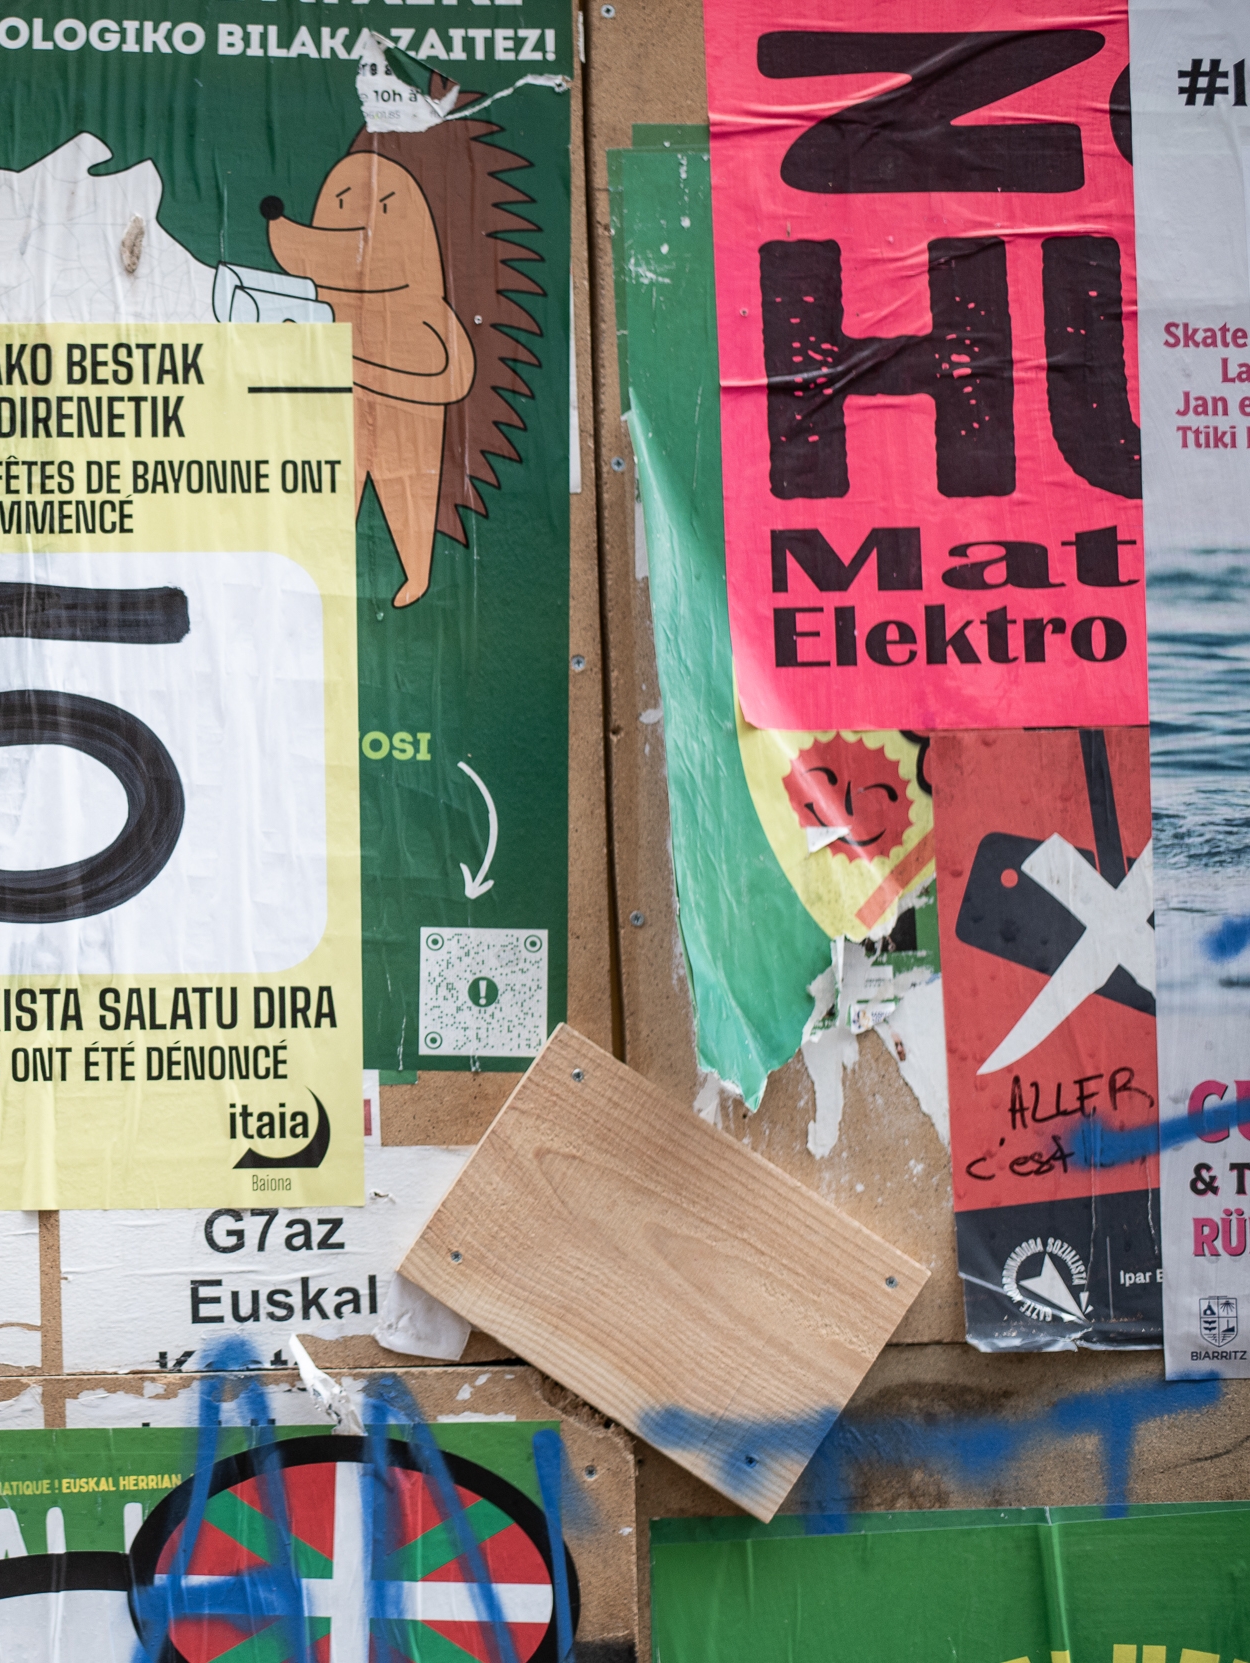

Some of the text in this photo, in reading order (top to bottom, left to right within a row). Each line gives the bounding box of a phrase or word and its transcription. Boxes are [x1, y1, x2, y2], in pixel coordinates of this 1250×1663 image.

[390, 27, 556, 61] ZAITEZ!
[1163, 321, 1248, 348] Skate
[66, 342, 204, 385] BESTAK
[1175, 391, 1229, 417] Jan
[1176, 425, 1237, 449] Ttiki
[86, 460, 121, 494] DE
[132, 459, 270, 494] BAYONNE
[279, 459, 341, 493] ONT
[769, 525, 1140, 593] Mat
[773, 602, 1128, 669] Elektro
[357, 731, 431, 761] OSI
[98, 986, 238, 1031] SALATU
[253, 985, 337, 1029] DIRA
[11, 1047, 72, 1083] ONT
[83, 1041, 136, 1082] ÉTÉ
[146, 1039, 288, 1081] DÉNONCÉ
[229, 1102, 309, 1139] itaia
[251, 1174, 292, 1192] Baiona
[1190, 1162, 1220, 1197] &
[203, 1208, 347, 1255] G7az
[1192, 1208, 1250, 1257] RÜ
[1120, 1269, 1152, 1288] Ipar
[190, 1274, 379, 1325] Euskal
[1191, 1350, 1248, 1361] BIARRITZ
[61, 1476, 116, 1493] EUSKAL
[119, 1473, 182, 1491] HERRIAN
